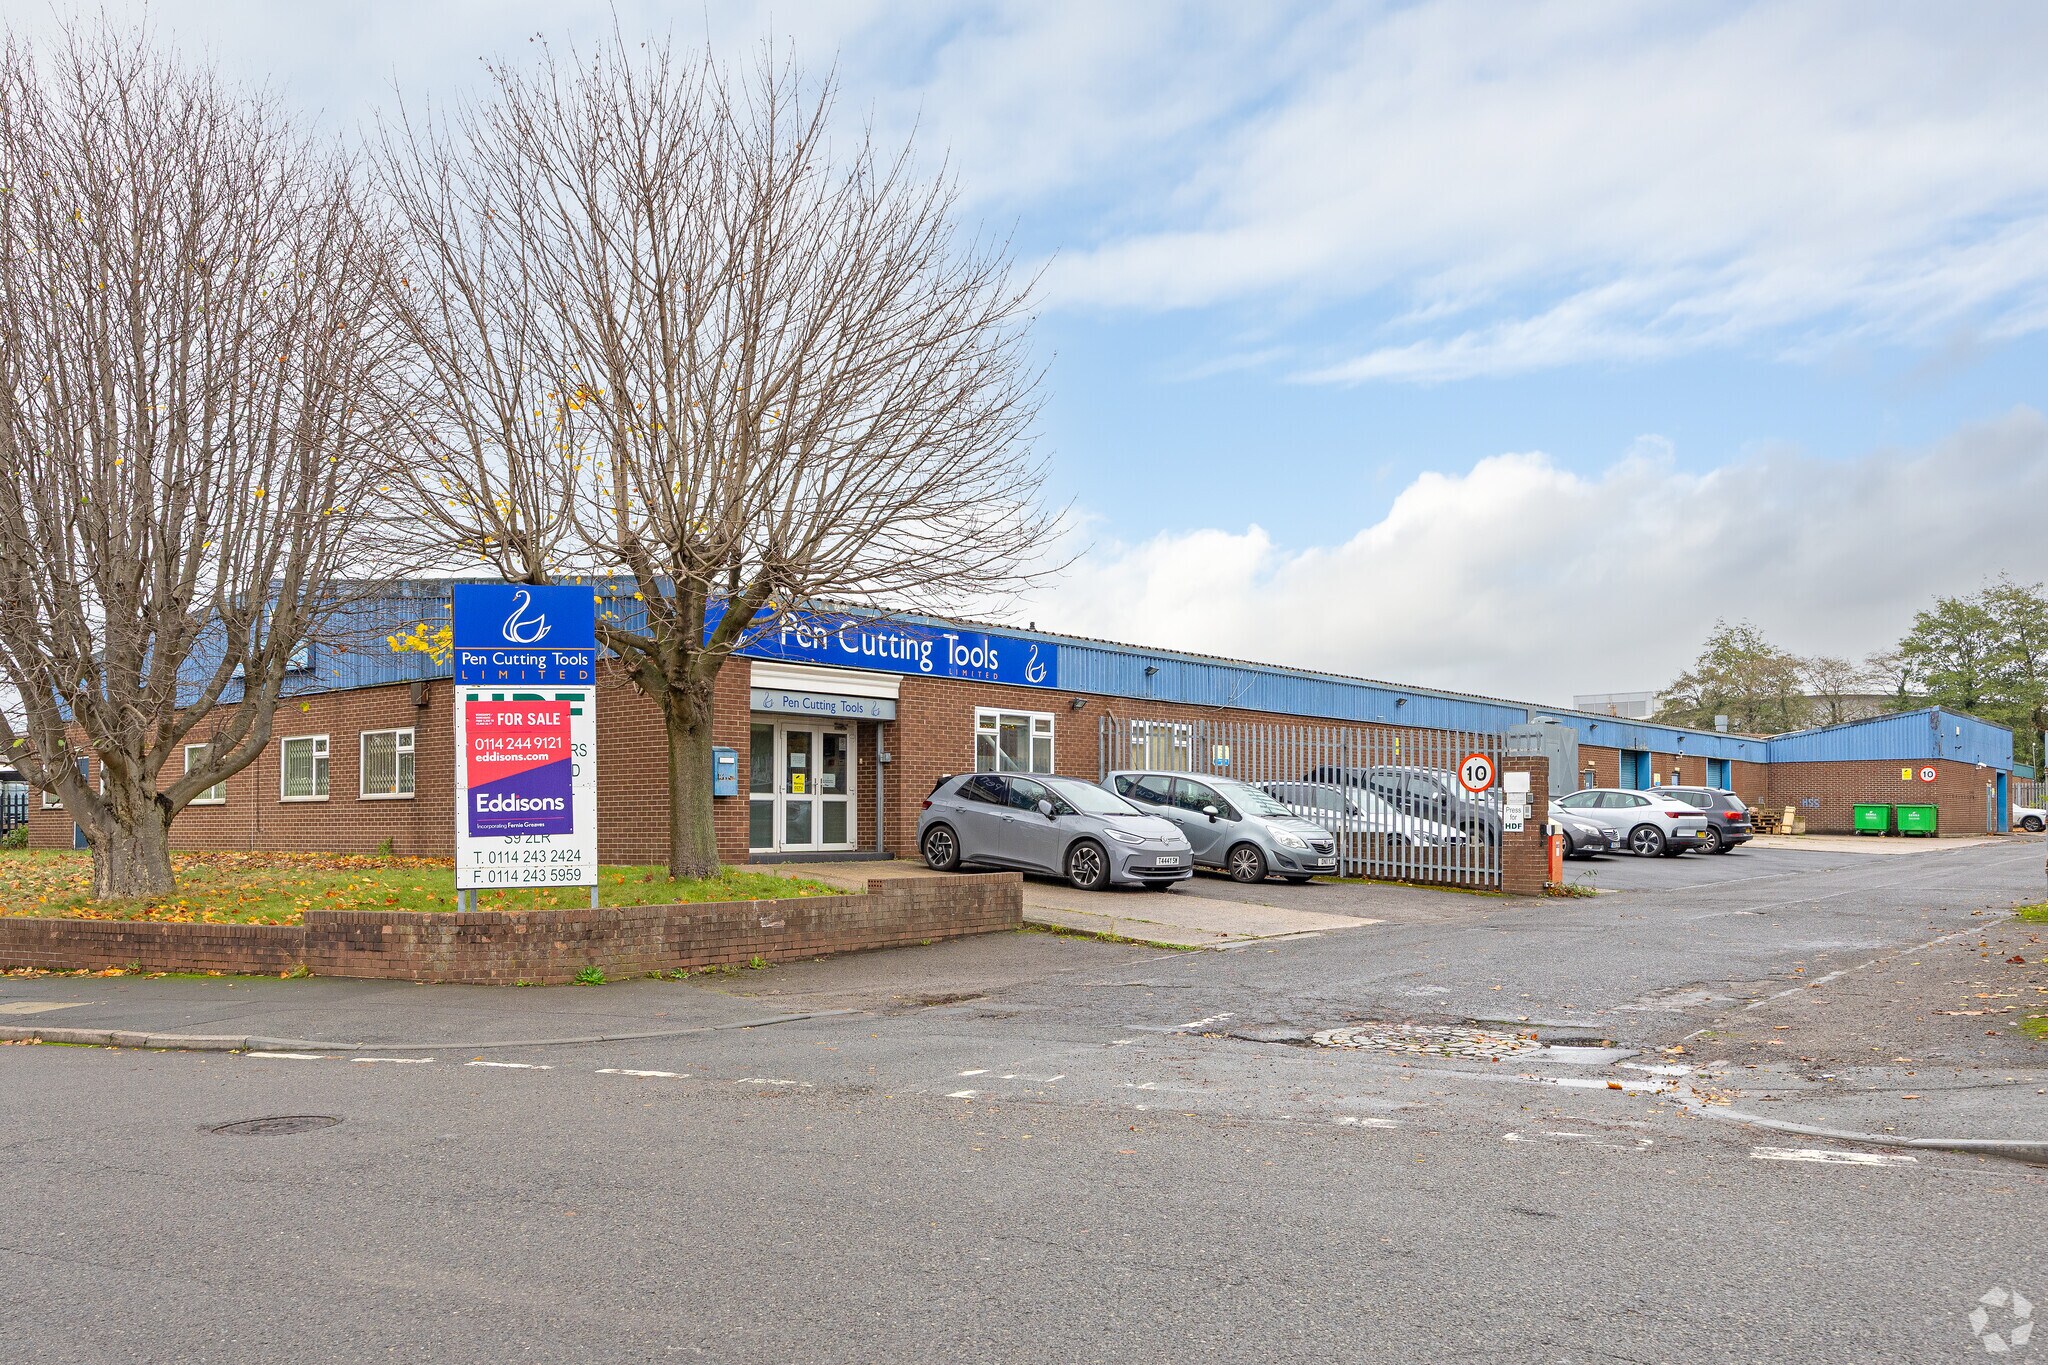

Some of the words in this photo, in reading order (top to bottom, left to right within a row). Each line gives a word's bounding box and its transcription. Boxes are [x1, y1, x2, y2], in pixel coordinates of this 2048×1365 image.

[781, 612, 827, 649] Pen
[839, 620, 933, 672] Cutting
[943, 633, 999, 670] Tools
[462, 652, 487, 665] Pen
[492, 652, 546, 669] Cutting
[552, 652, 588, 666] Tools
[461, 670, 588, 680] LIMITED
[949, 668, 998, 680] LIMITED
[782, 696, 800, 709] Pen
[802, 697, 836, 714] Cutting
[840, 700, 864, 713] Tools
[497, 712, 523, 726] FOR
[527, 712, 561, 726] SALE
[474, 738, 504, 751] 0114
[505, 738, 532, 750] 244
[533, 736, 562, 750] 9121
[475, 751, 549, 763] eddisons.com
[1466, 765, 1487, 782] 10
[476, 793, 565, 813] Eddisons
[1505, 806, 1522, 814] Press
[1505, 822, 1522, 830] HDF
[473, 851, 484, 864] T.
[488, 851, 519, 864] 0114
[523, 850, 547, 863] 243
[550, 849, 581, 863] 2424
[473, 870, 484, 883] F.
[488, 869, 519, 883] 0114
[522, 869, 547, 882] 243
[550, 868, 581, 882] 5959
